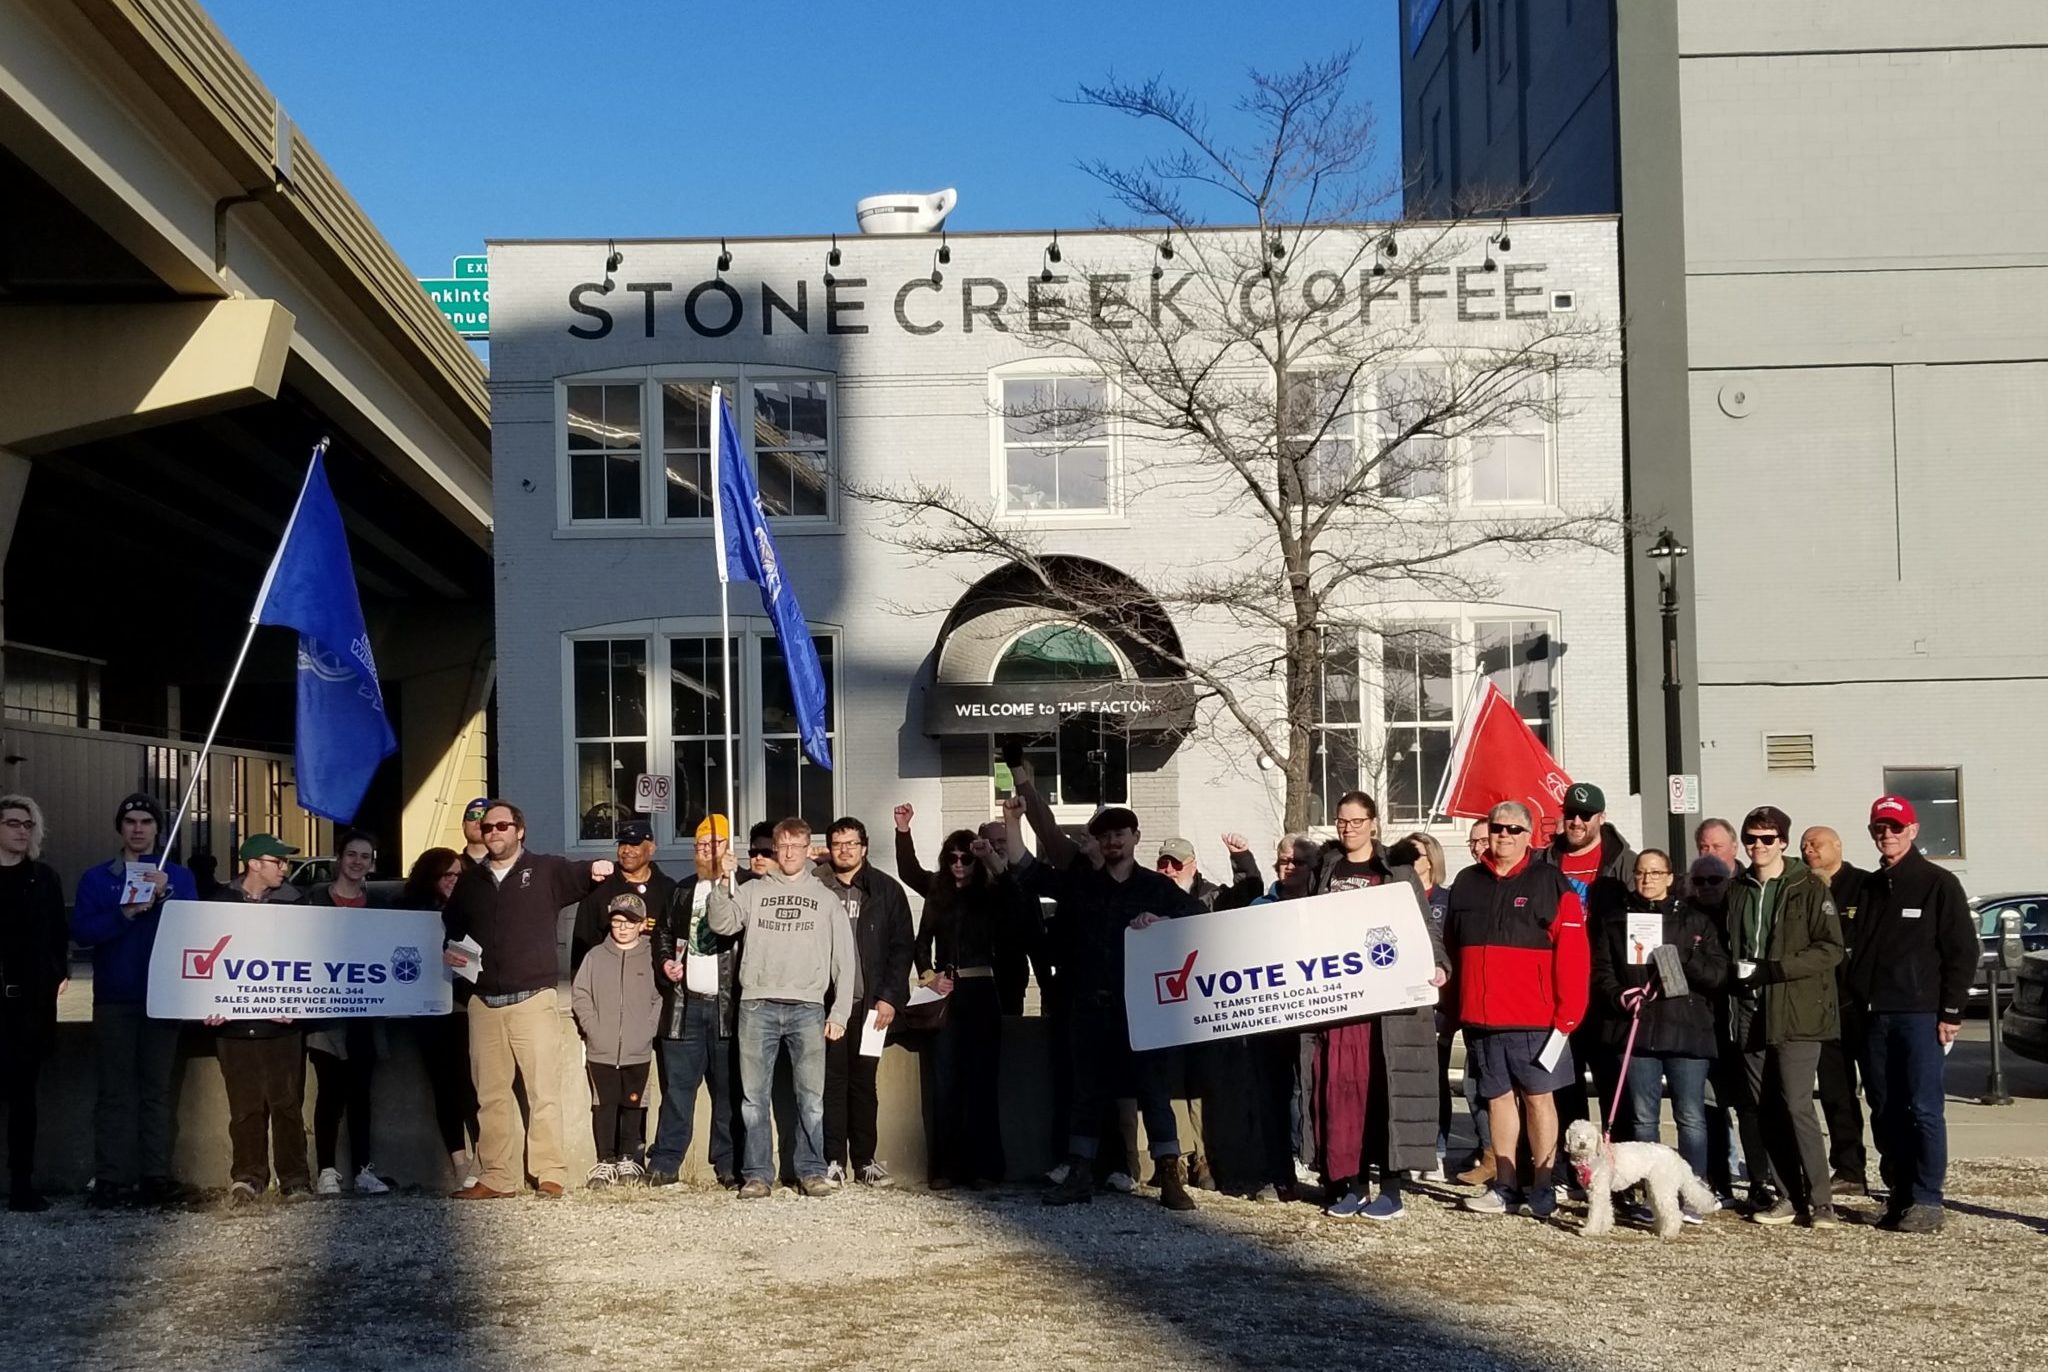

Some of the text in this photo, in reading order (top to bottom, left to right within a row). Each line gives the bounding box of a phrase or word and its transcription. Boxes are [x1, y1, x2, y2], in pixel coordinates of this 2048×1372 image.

[567, 263, 1549, 340] STONE CREEK COFFEE
[955, 703, 1034, 717] WELCOME
[1038, 703, 1055, 715] to
[1058, 701, 1087, 713] THE
[760, 895, 818, 911] OSHKOSH
[757, 918, 815, 932] MIGHTY PIGS
[223, 958, 387, 984] VOTE YES
[1194, 951, 1364, 998] VOTE YES
[214, 995, 385, 1005] SALES AND SERVICE INDUSTRY
[237, 985, 364, 995] TEAMSTERS LOCAL 344
[1213, 982, 1342, 1009] TEAMSTERS LOCAL 344
[232, 1006, 367, 1014] MILWAUKEE, WISCONSIN
[1193, 989, 1365, 1025] SALES AND SERVICE INDUSTRY
[1212, 1003, 1348, 1033] MILWAUKEE, WISCONSIN
